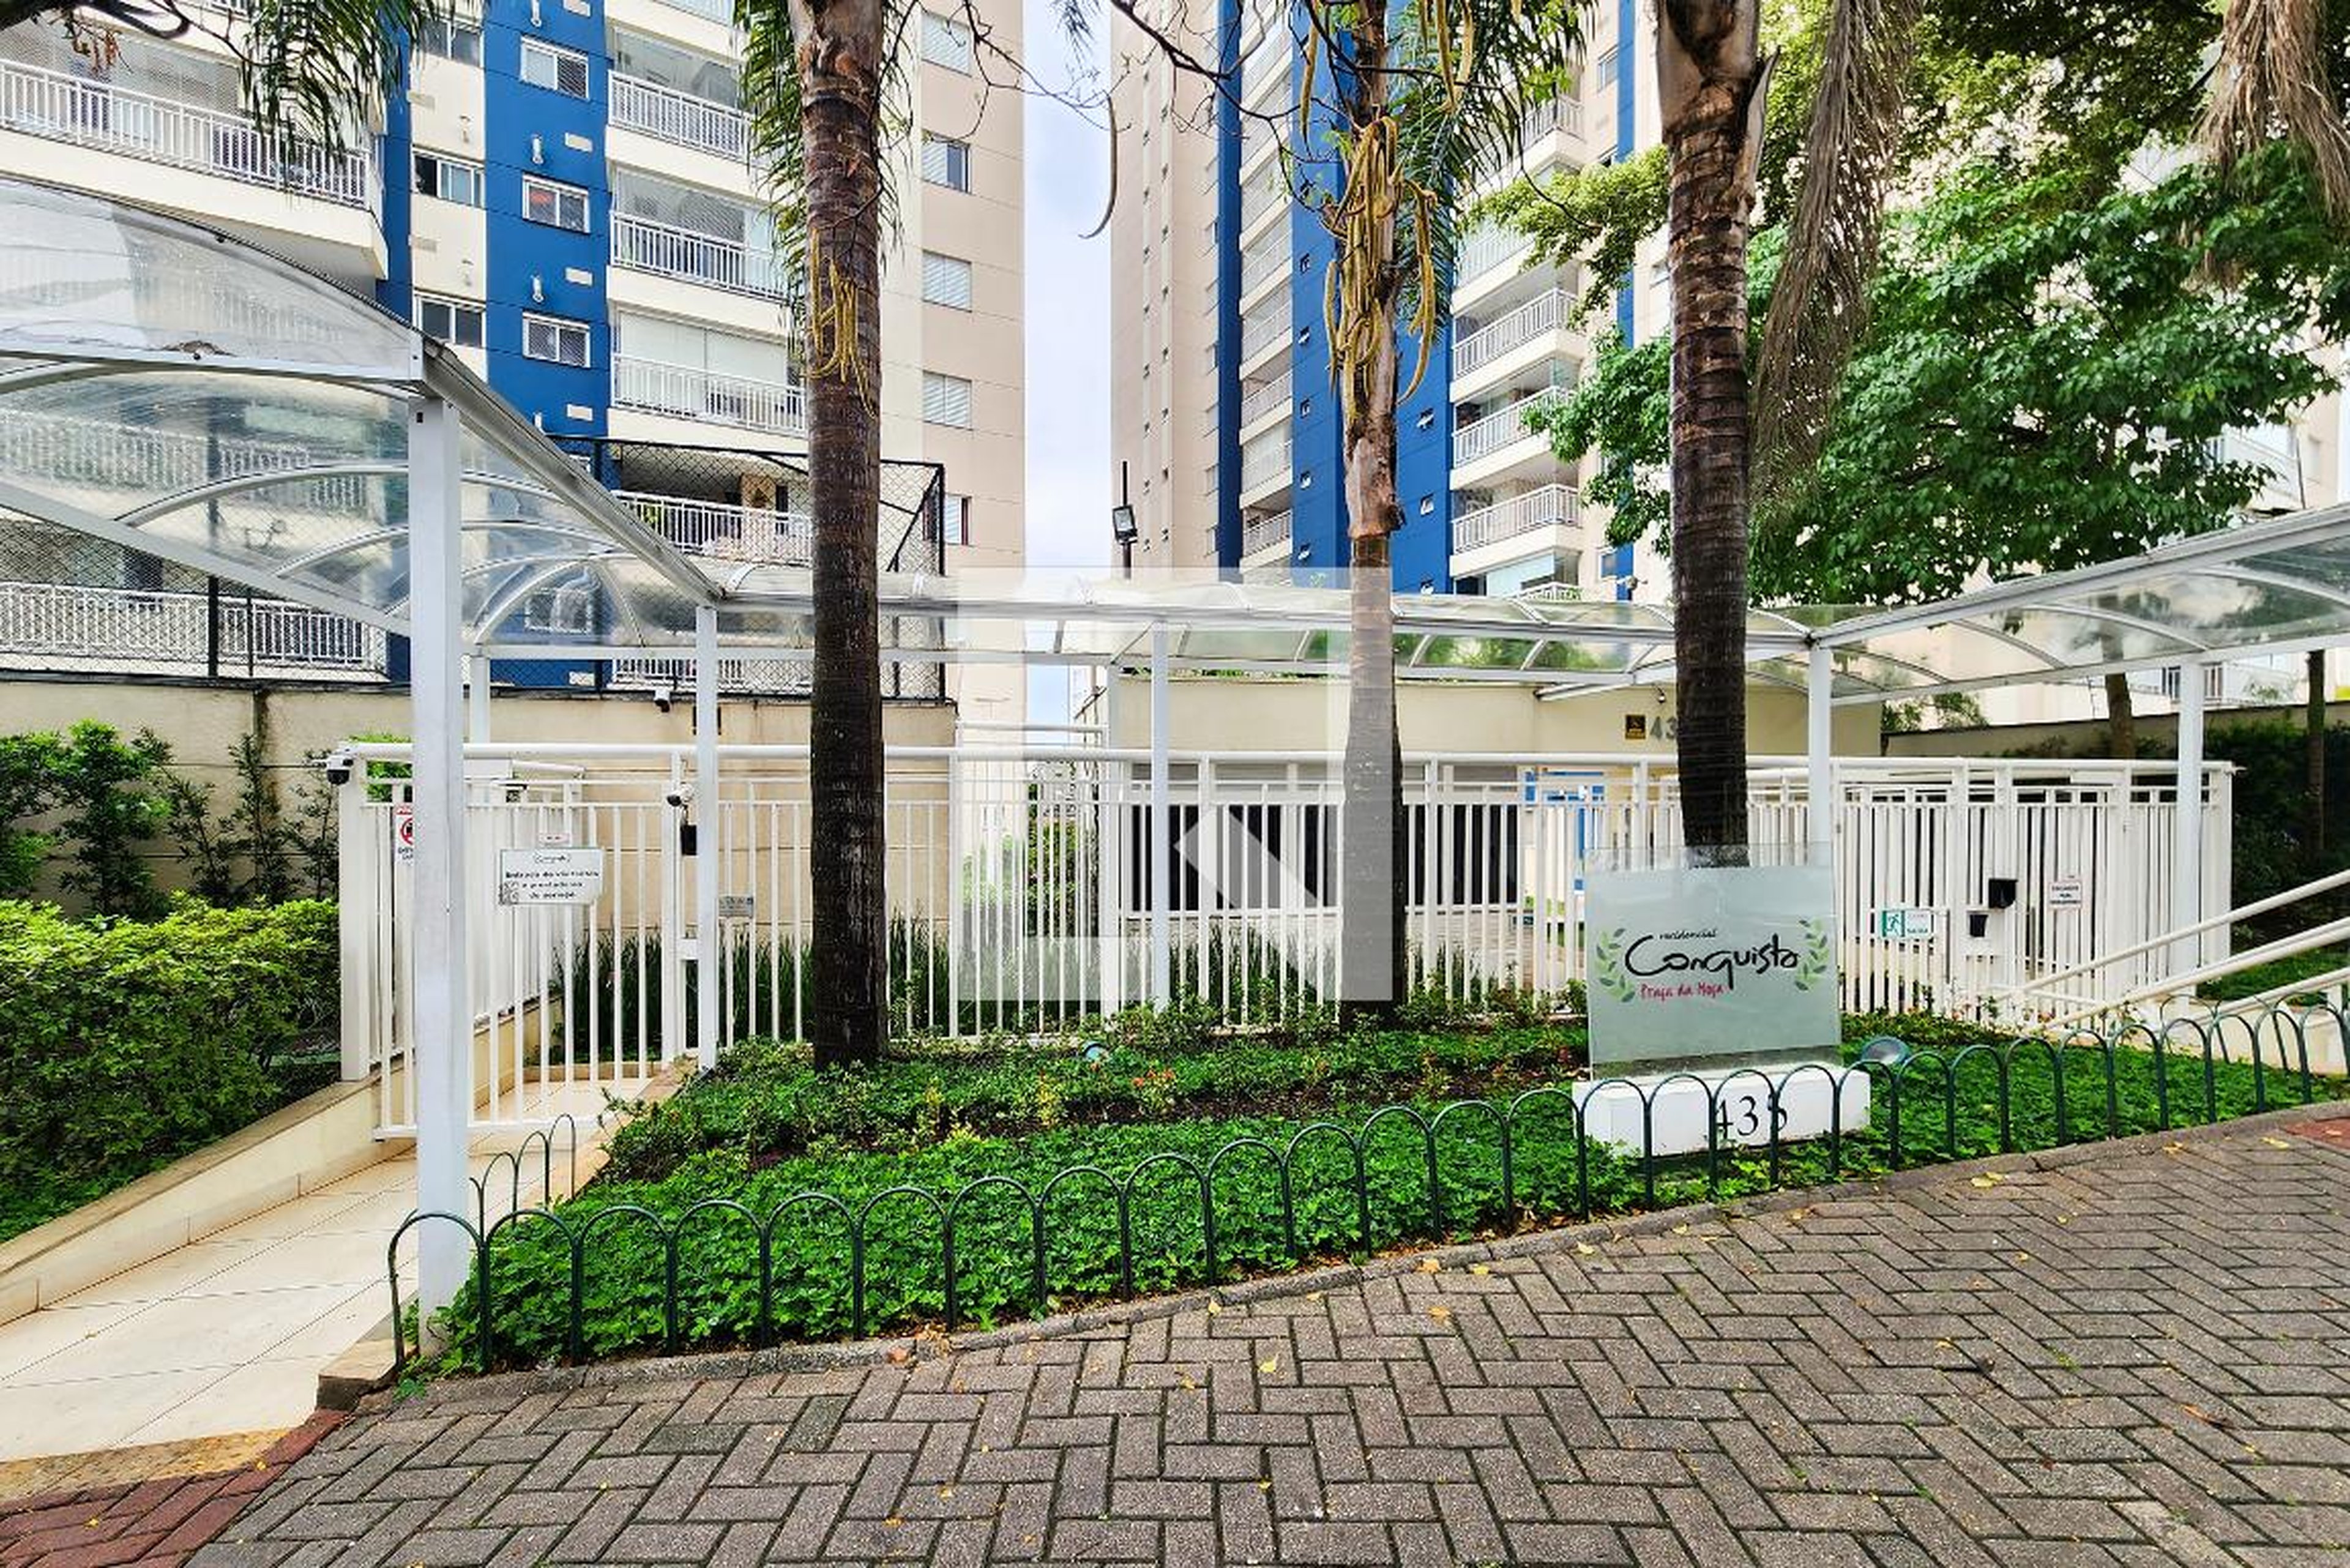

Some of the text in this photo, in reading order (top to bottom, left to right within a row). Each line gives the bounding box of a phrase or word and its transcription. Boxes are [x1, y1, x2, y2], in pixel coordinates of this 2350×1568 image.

[1659, 928, 1717, 940] residencial
[1625, 933, 1801, 990] Conquista
[1641, 982, 1724, 1002] Praça da Moça
